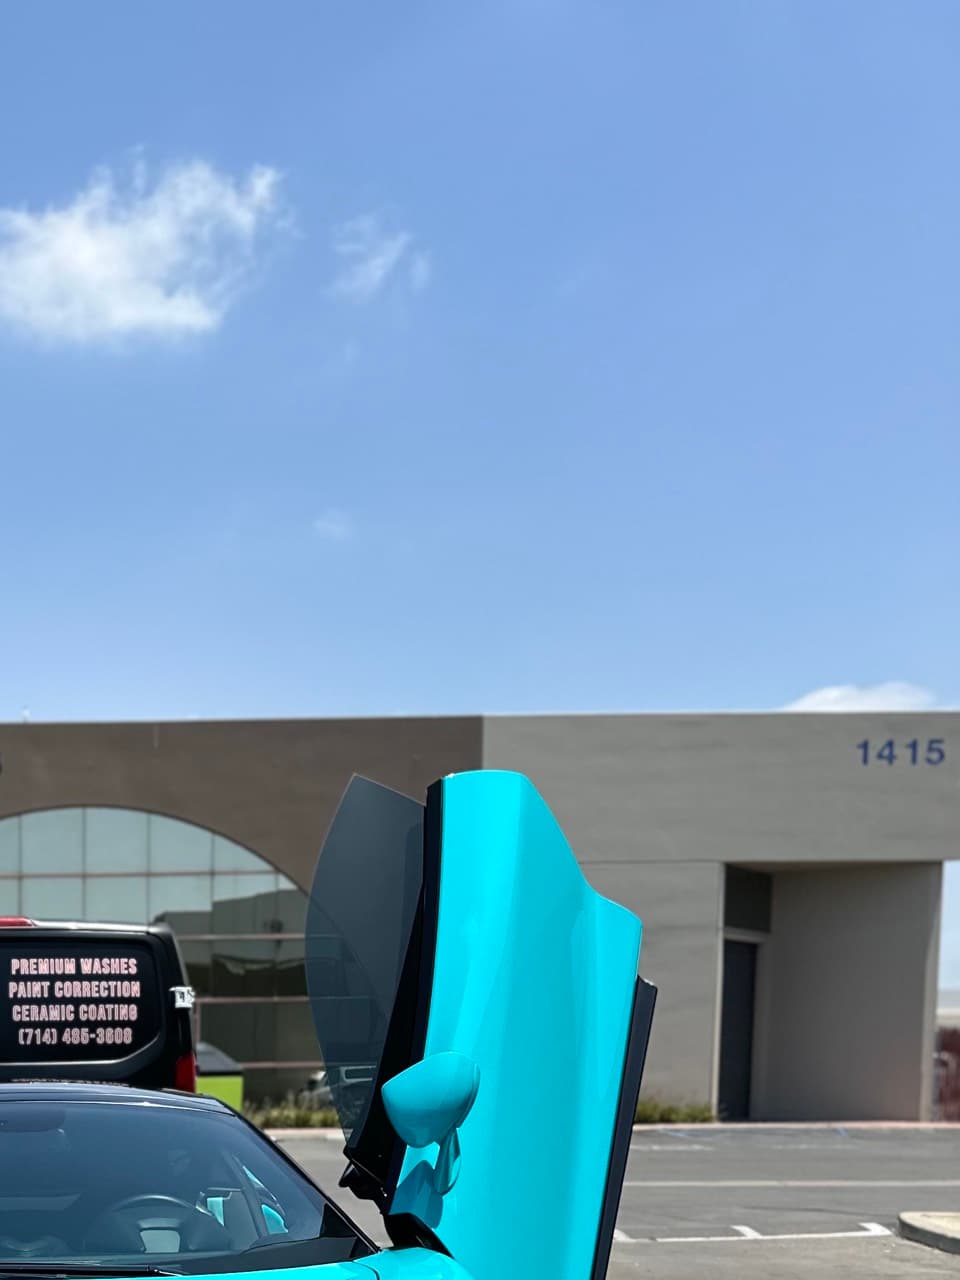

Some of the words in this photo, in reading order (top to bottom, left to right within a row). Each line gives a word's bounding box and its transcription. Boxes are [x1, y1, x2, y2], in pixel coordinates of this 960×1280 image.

[856, 739, 946, 766] 1415
[11, 958, 76, 975] PREMIUM
[80, 958, 138, 975] WASHES
[8, 981, 50, 998] PAINT
[54, 981, 140, 998] CORRECTION
[12, 1004, 75, 1021] CERAMIC
[79, 1004, 138, 1021] COATING
[18, 1027, 58, 1045] (714)
